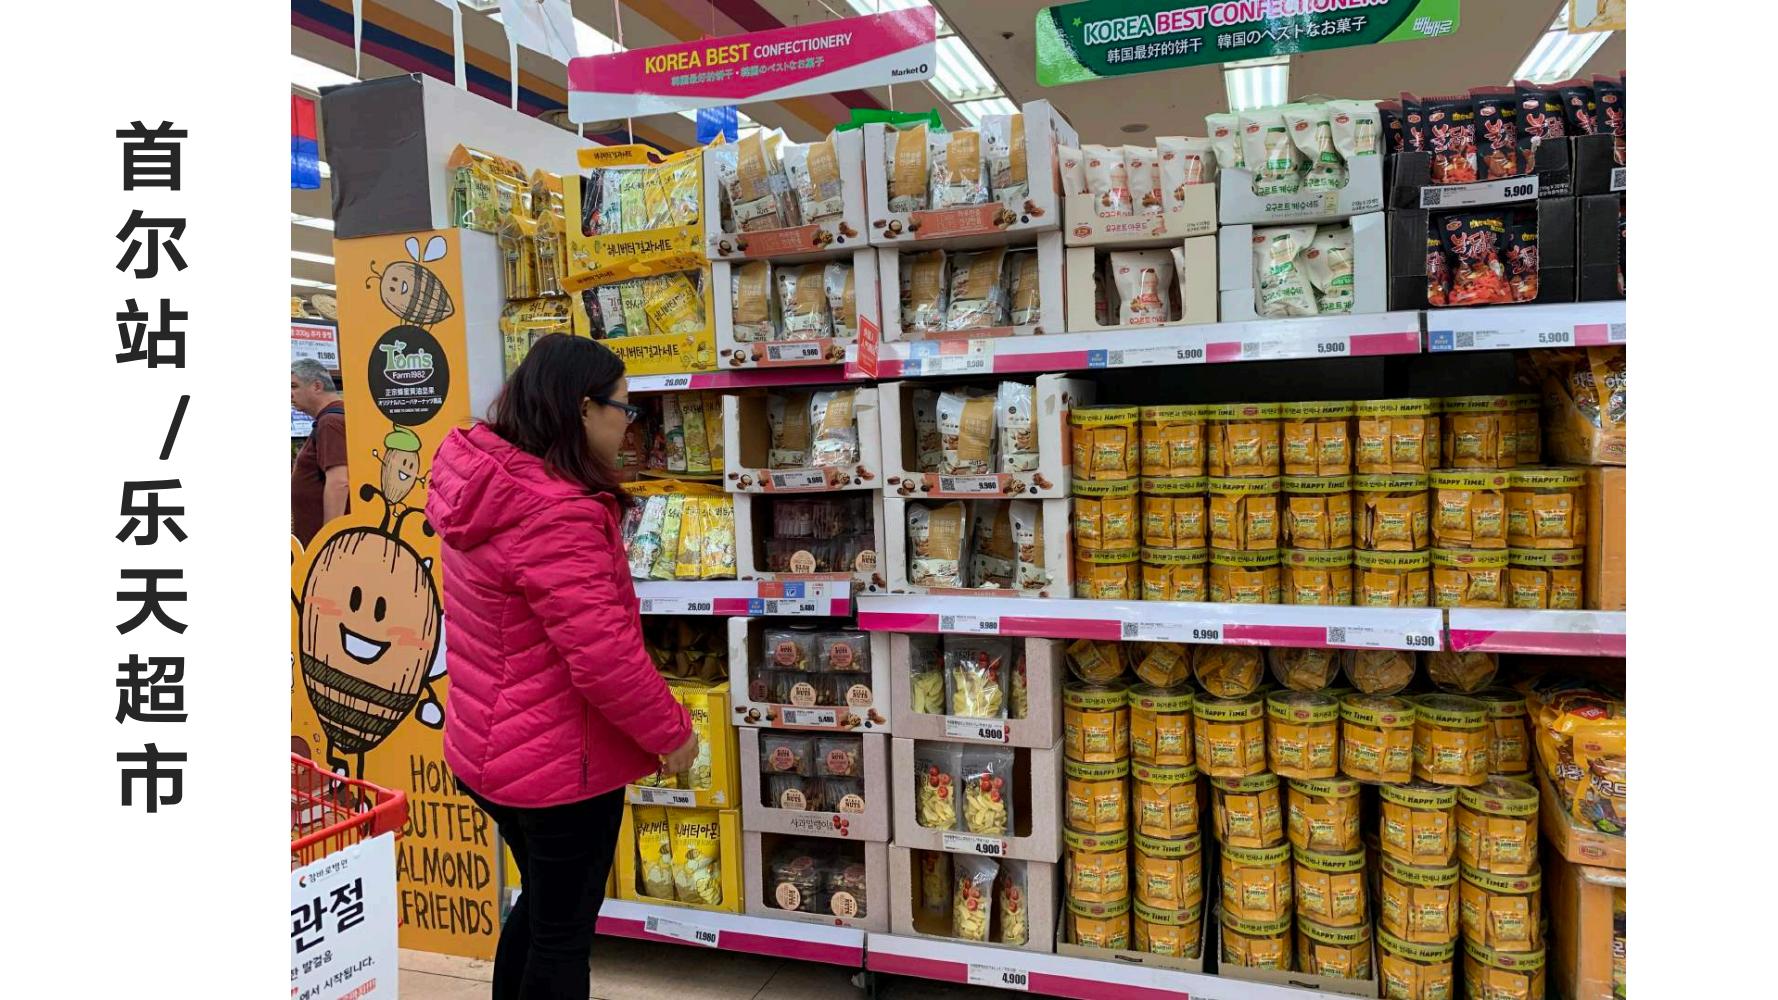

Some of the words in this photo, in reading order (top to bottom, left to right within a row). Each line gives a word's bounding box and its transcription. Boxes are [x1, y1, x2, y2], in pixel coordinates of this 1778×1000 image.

[1084, 16, 1153, 45] KOREA
[1156, 6, 1208, 34] BEST
[645, 50, 702, 74] KOREA
[706, 43, 751, 66] BEST
[753, 33, 853, 59] CONFECTIONERY
[1107, 38, 1203, 64] 韩国最好的饼干
[891, 66, 919, 77] Market
[919, 63, 928, 74] O
[1504, 184, 1533, 198] 5,900
[1539, 332, 1569, 343] 5,900
[1317, 342, 1345, 353] 5,900
[380, 343, 434, 370] Tom's
[1177, 348, 1203, 360] 5,900
[1322, 405, 1345, 413] HAPPY
[1104, 413, 1125, 421] HAPPY
[1301, 481, 1325, 489] HAPPY
[1389, 480, 1413, 488] HAPPY
[1438, 478, 1460, 486] HAPPY
[1463, 477, 1486, 487] TIME!
[1531, 475, 1560, 484] HAPPY
[1398, 555, 1421, 564] HAPPY
[1193, 628, 1219, 640] 9,990
[1406, 634, 1435, 647] 9,990
[1205, 708, 1227, 717] HAPPY
[1229, 708, 1247, 717] TIME!
[1353, 712, 1374, 722] TIME!
[1436, 714, 1462, 724] HAPPY
[978, 728, 1003, 739] 4,900
[410, 754, 470, 797] HON
[1310, 784, 1330, 794] TIME!
[1407, 796, 1434, 805] HAPPY
[975, 843, 1000, 855] 4,900
[1163, 844, 1181, 853] TIME!
[397, 845, 491, 891] ALMOND
[1322, 859, 1346, 868] HAPPY
[1485, 876, 1509, 889] TIME!
[291, 877, 365, 954] 관절
[401, 889, 493, 937] FRIENDS
[1152, 911, 1171, 922] TIME!
[1312, 927, 1335, 940] HAPPY
[1336, 932, 1357, 941] TIME!
[1419, 947, 1443, 957] HAPPY
[302, 950, 334, 975] 발걸음
[323, 955, 376, 989] 시작됩니다.
[1002, 972, 1026, 985] 4,900
